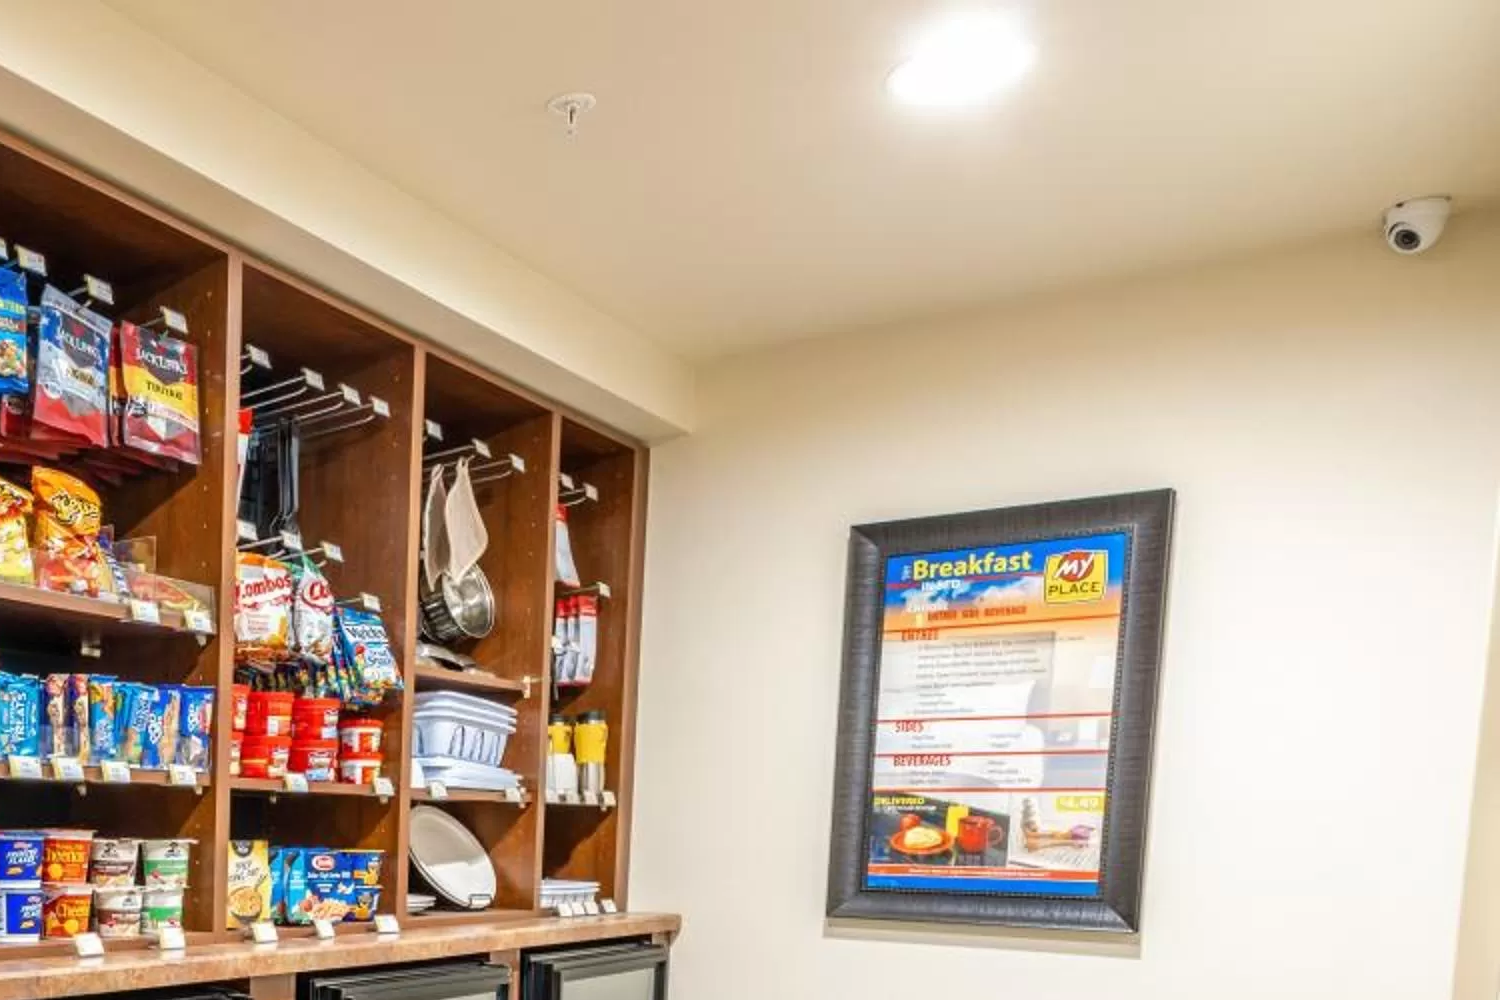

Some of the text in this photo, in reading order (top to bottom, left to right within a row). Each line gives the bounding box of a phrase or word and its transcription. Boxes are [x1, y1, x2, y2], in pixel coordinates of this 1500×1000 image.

[912, 550, 1034, 581] Breakfast
[1047, 581, 1102, 597] PLACE
[893, 755, 952, 768] BEVERAGES
